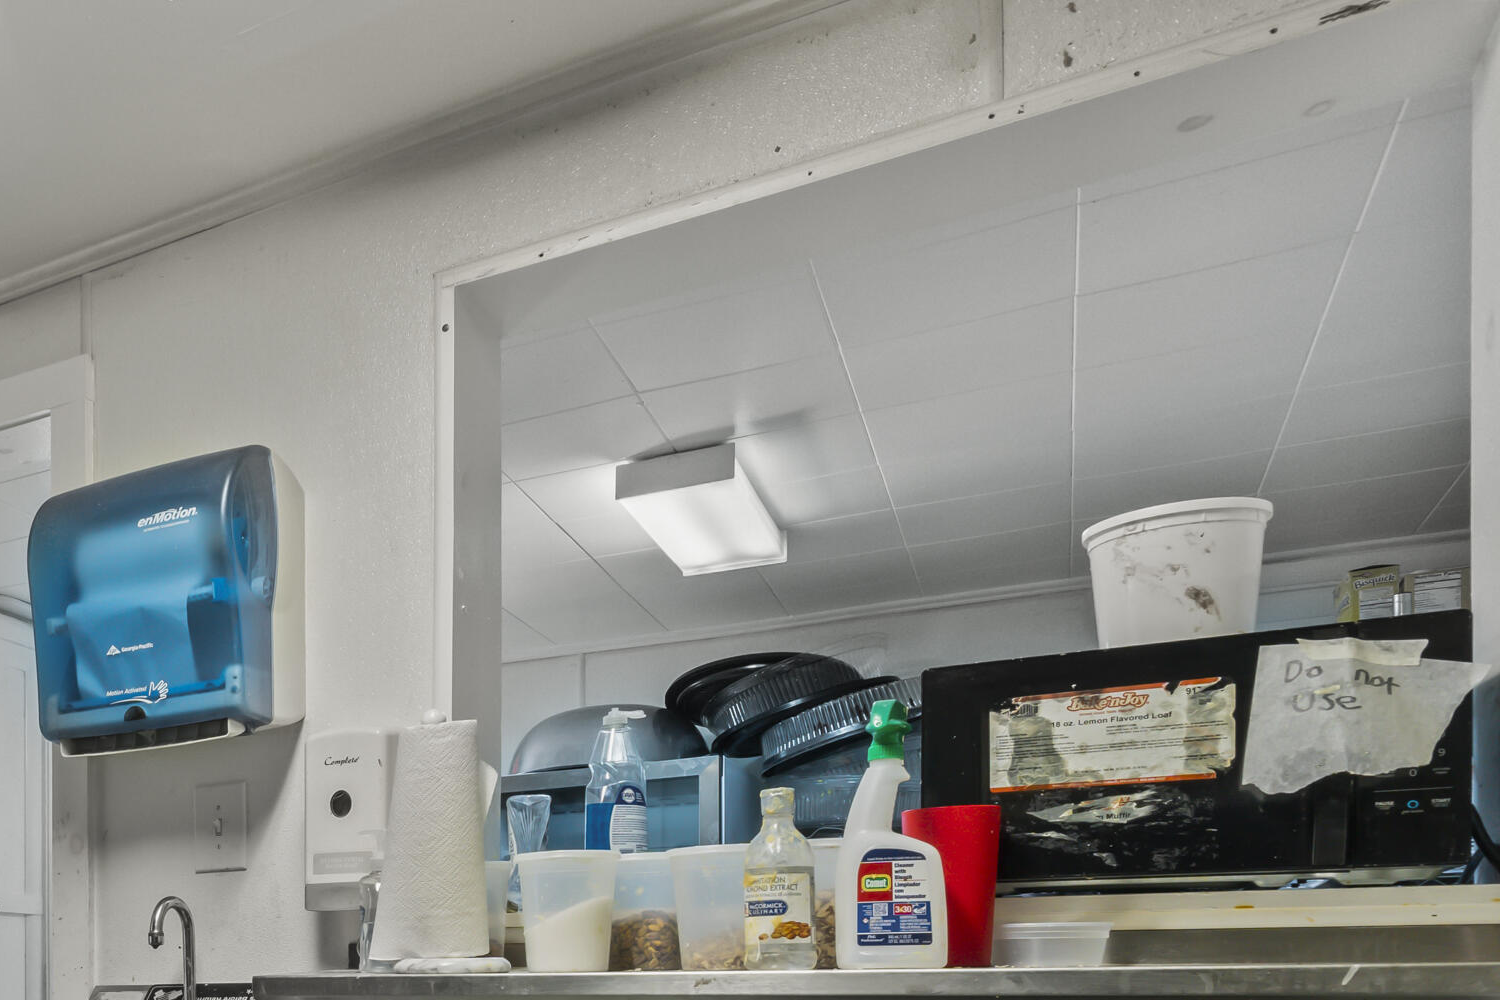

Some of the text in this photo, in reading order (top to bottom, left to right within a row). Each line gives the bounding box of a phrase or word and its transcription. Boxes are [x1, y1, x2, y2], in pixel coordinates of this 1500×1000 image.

[137, 506, 197, 528] enMotion
[1354, 573, 1396, 590] Bisquick
[1284, 659, 1324, 684] Do
[1078, 715, 1108, 726] Lemon
[1110, 713, 1149, 722] Flavored
[1151, 711, 1173, 719] Loaf
[1438, 748, 1446, 757] 9
[324, 756, 360, 767] Complete
